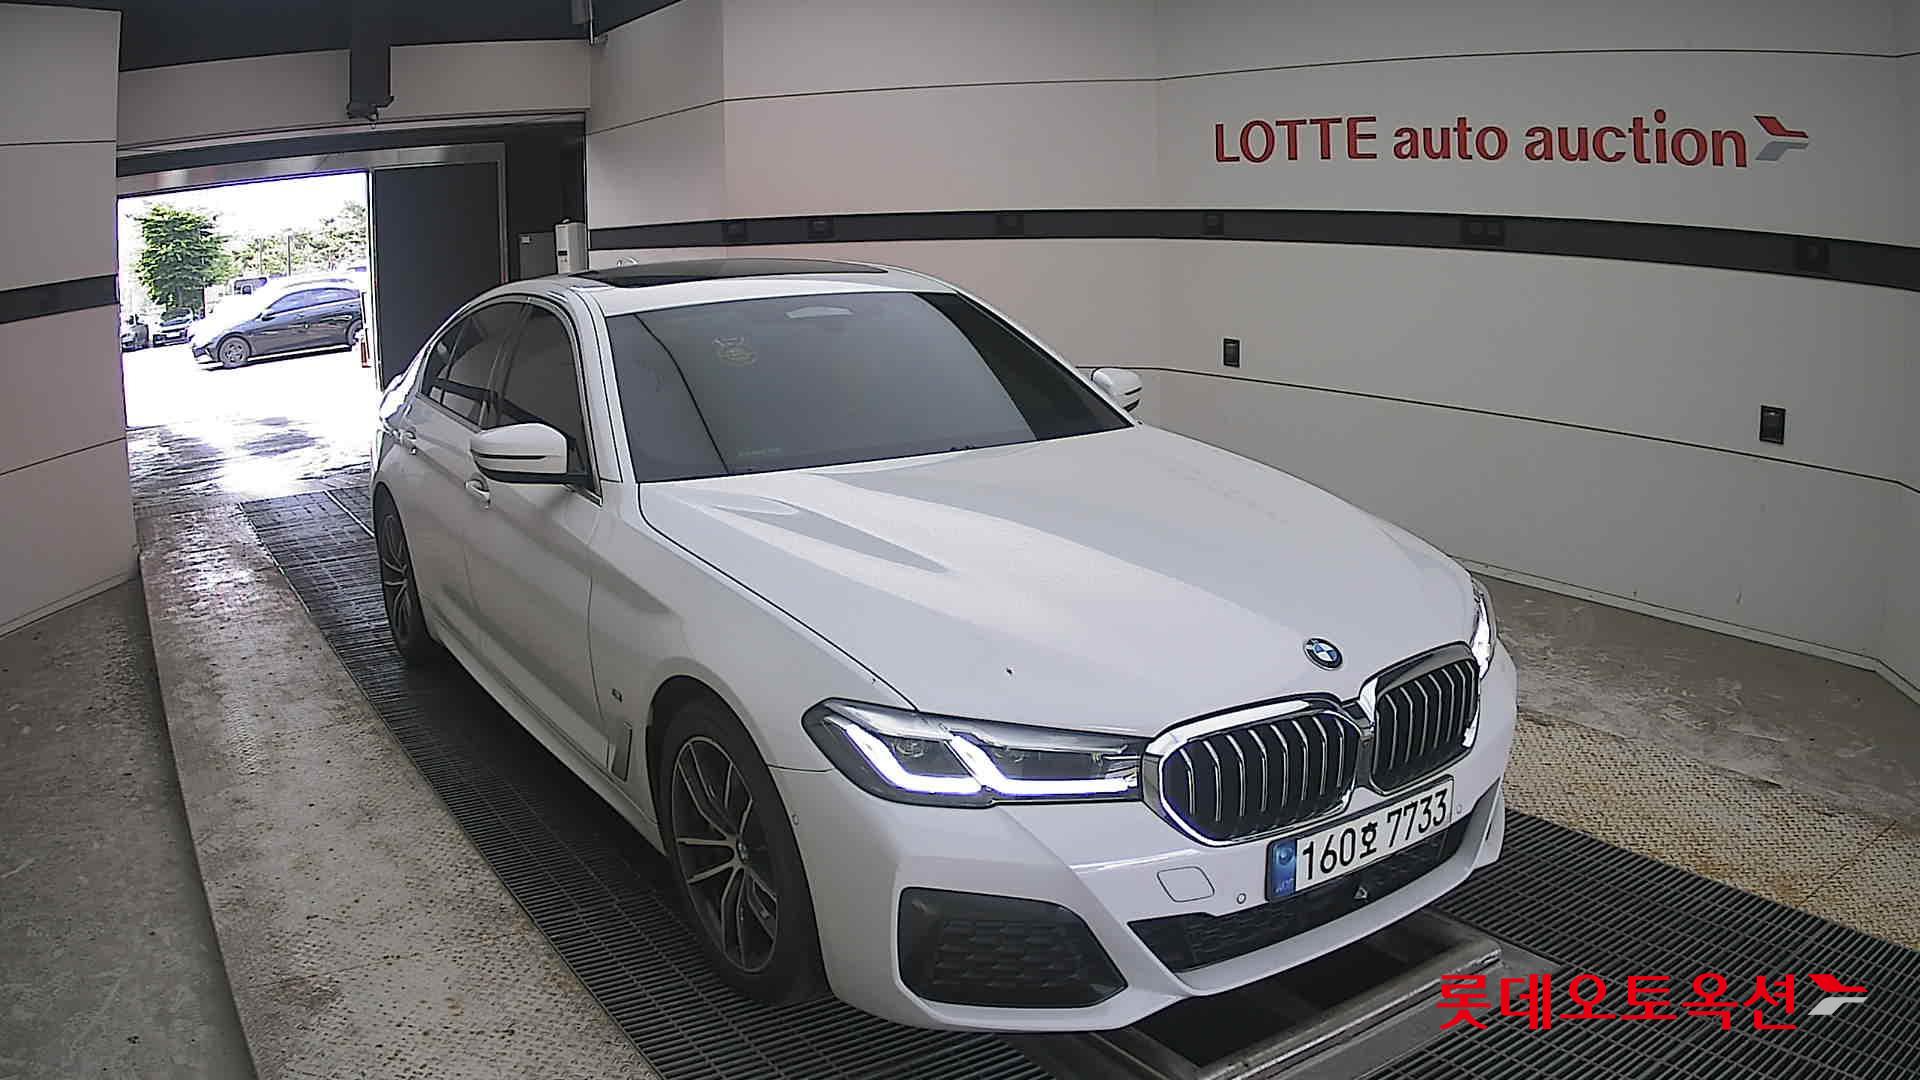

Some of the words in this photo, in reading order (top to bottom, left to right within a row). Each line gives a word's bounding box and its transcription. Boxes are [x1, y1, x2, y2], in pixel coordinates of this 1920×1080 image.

[1215, 116, 1377, 163] LOTTE
[1392, 117, 1509, 161] auto
[1524, 109, 1748, 168] auction
[1302, 821, 1378, 880] 160호
[1386, 788, 1448, 848] 7733
